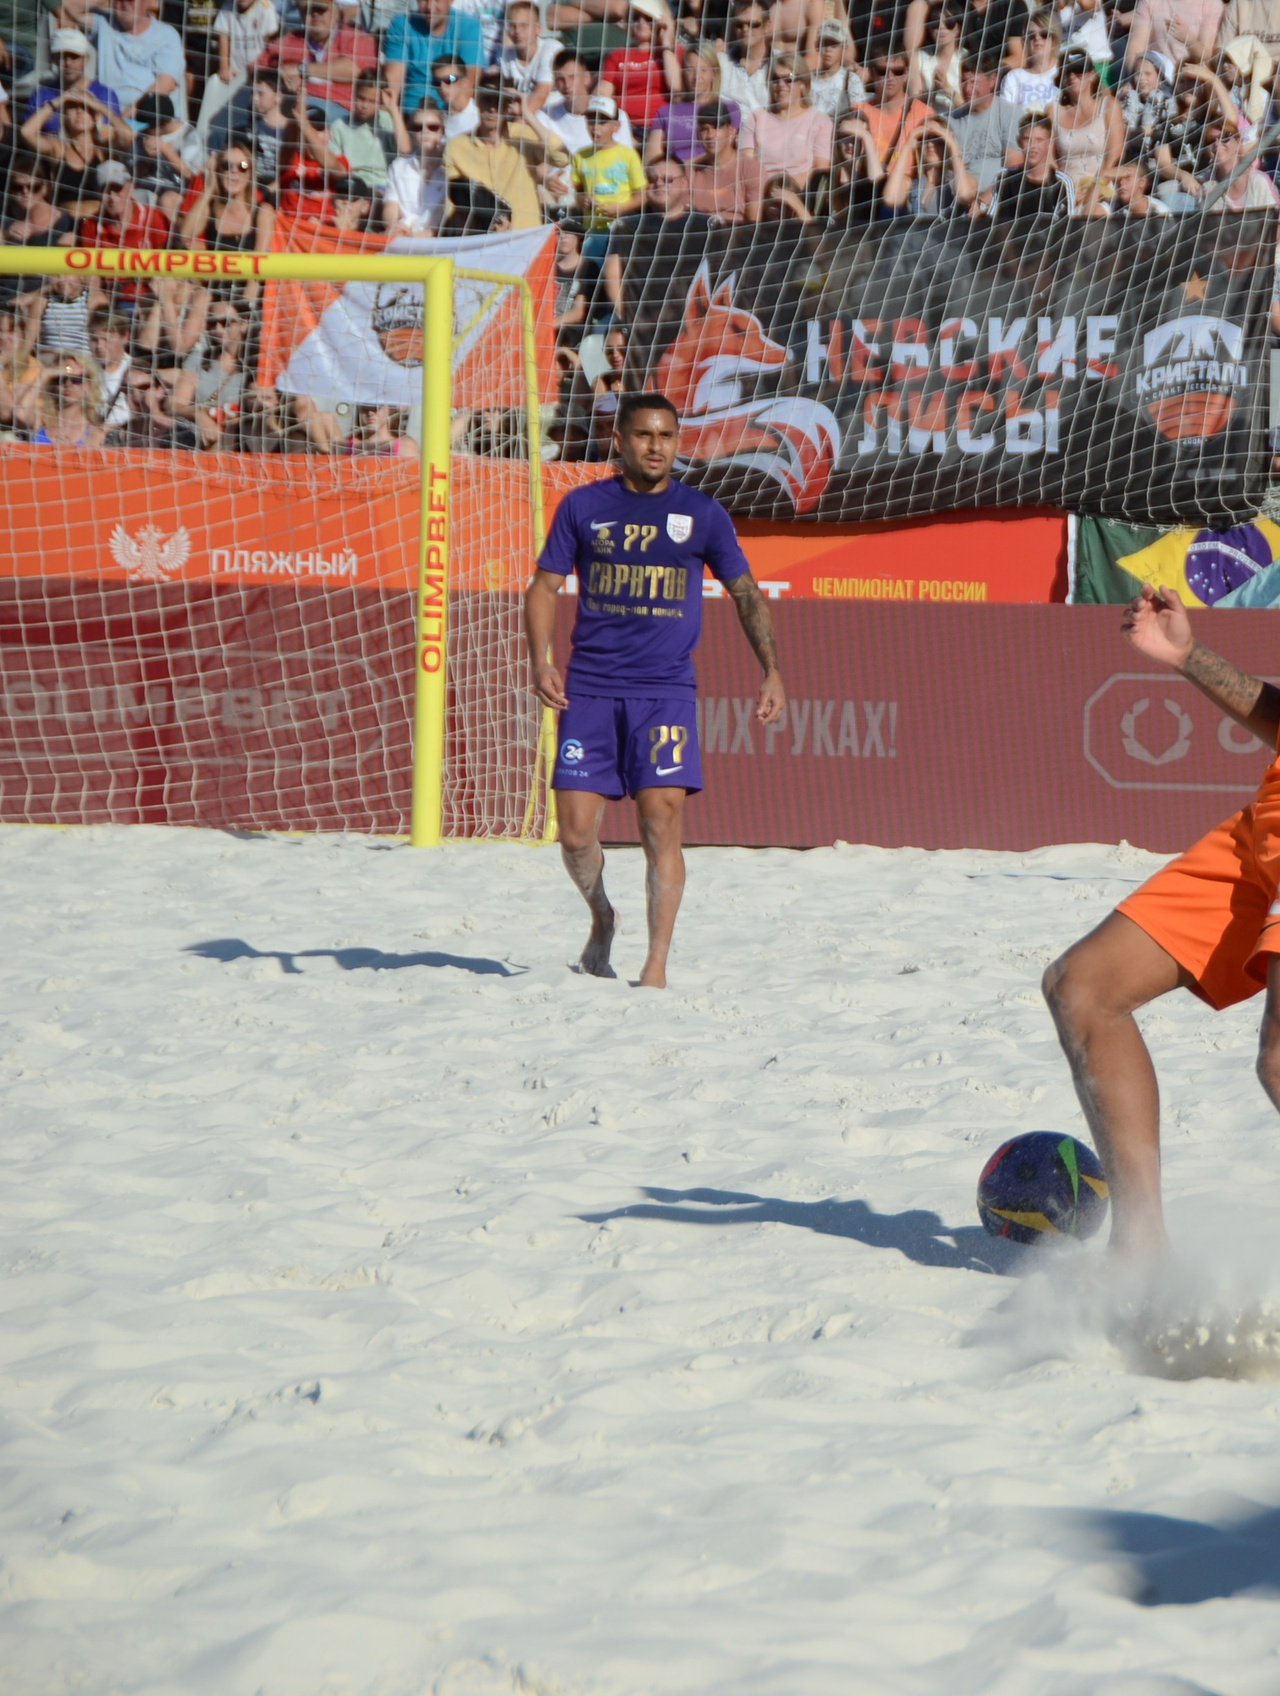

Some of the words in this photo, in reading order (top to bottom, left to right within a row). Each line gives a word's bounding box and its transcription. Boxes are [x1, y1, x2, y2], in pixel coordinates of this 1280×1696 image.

[64, 249, 268, 275] OLIMPBET
[806, 315, 1119, 383] НЕВСКИЕ
[1135, 360, 1248, 396] КРИСТАЛЛ
[857, 389, 1061, 455] ЛИСЫ
[211, 548, 358, 577] ПЛЯЖНЫЙ
[421, 462, 447, 673] OLIMPBET
[587, 561, 688, 601] САРАТОВ
[812, 576, 914, 600] ЧЕМПИОНАТ
[918, 579, 987, 602] РОССИИ
[4, 681, 352, 731] OLIMPBET
